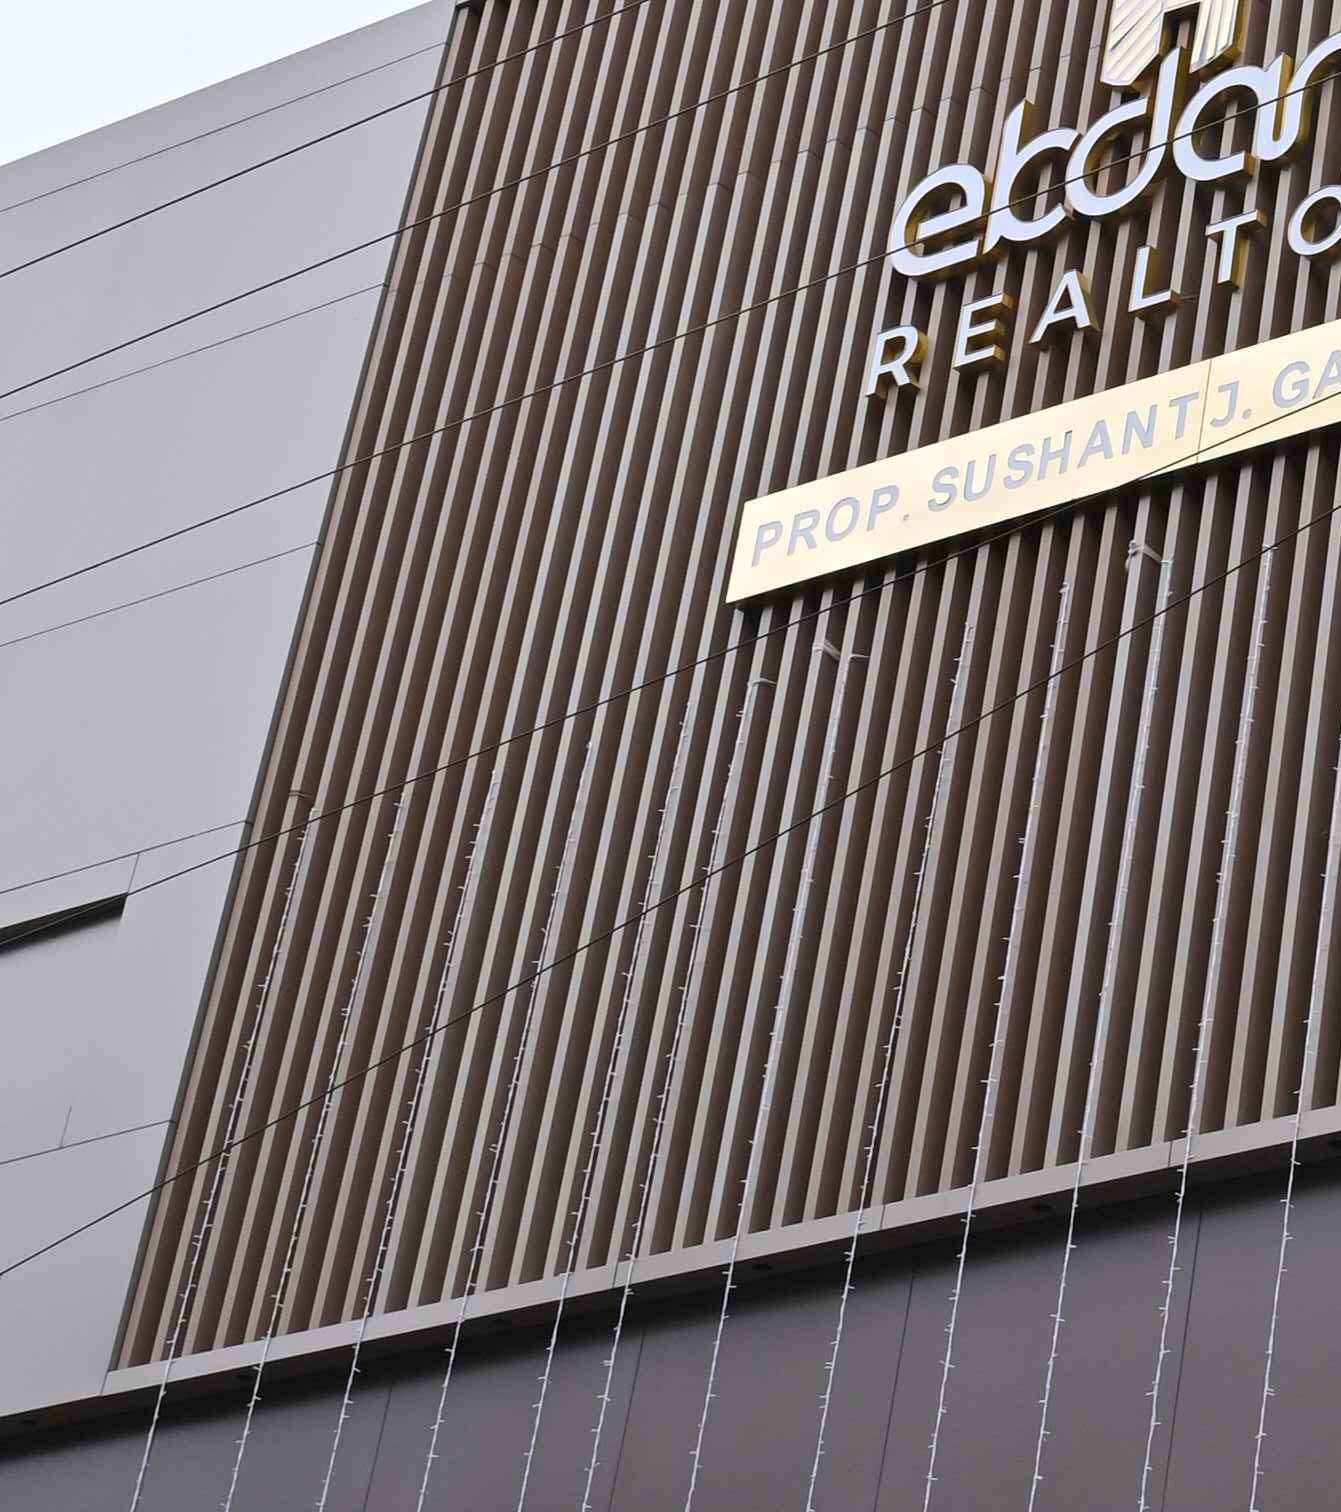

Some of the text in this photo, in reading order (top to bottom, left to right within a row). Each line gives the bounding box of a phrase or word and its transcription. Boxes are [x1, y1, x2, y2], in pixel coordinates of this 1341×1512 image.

[749, 488, 911, 569] PROP.
[928, 398, 1202, 514] SUSHANT
[1207, 378, 1254, 429] J.
